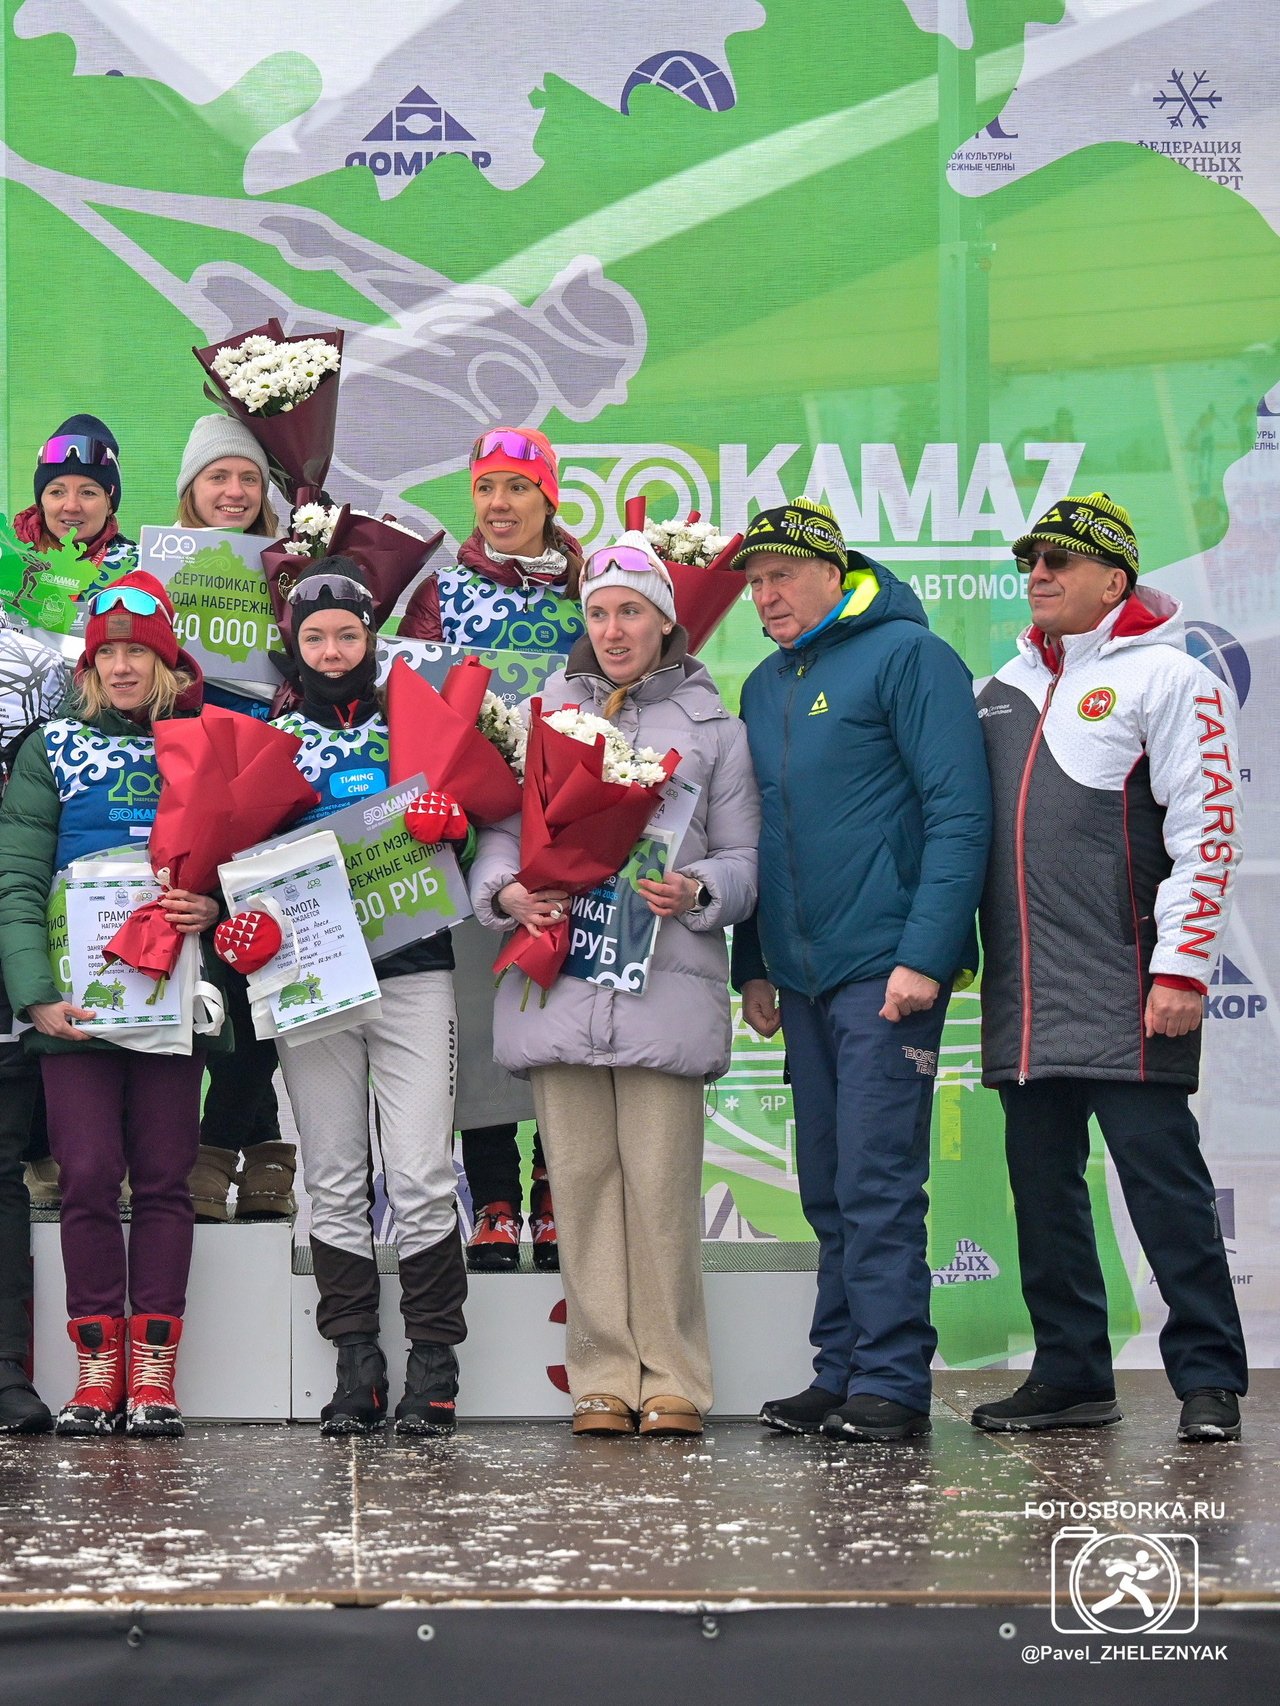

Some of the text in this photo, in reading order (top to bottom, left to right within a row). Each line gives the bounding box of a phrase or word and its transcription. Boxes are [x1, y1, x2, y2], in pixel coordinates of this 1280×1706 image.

[946, 163, 1016, 171] РЕЖНЫЕ ЧЕЛНЫ
[965, 151, 1012, 160] КУЛЬТУРЫ
[719, 442, 1087, 543] KAMAZ
[174, 571, 268, 595] СЕРТИФИКАТ О
[909, 574, 1030, 600] АВТОМО
[167, 590, 198, 607] РОДА
[209, 616, 257, 648] 000
[339, 772, 375, 784] TIMING
[347, 783, 370, 793] CHIP
[1174, 687, 1235, 961] TATARSTAN
[366, 845, 381, 862] ОТ
[349, 858, 403, 892] РЕЖНЫЕ
[403, 842, 447, 865] ЧЕЛНЫ
[388, 866, 439, 911] РУБ
[98, 910, 133, 922] ГРАМО
[324, 924, 342, 935] МЕСТО
[570, 927, 618, 965] РУБ
[1203, 994, 1268, 1019] КОР
